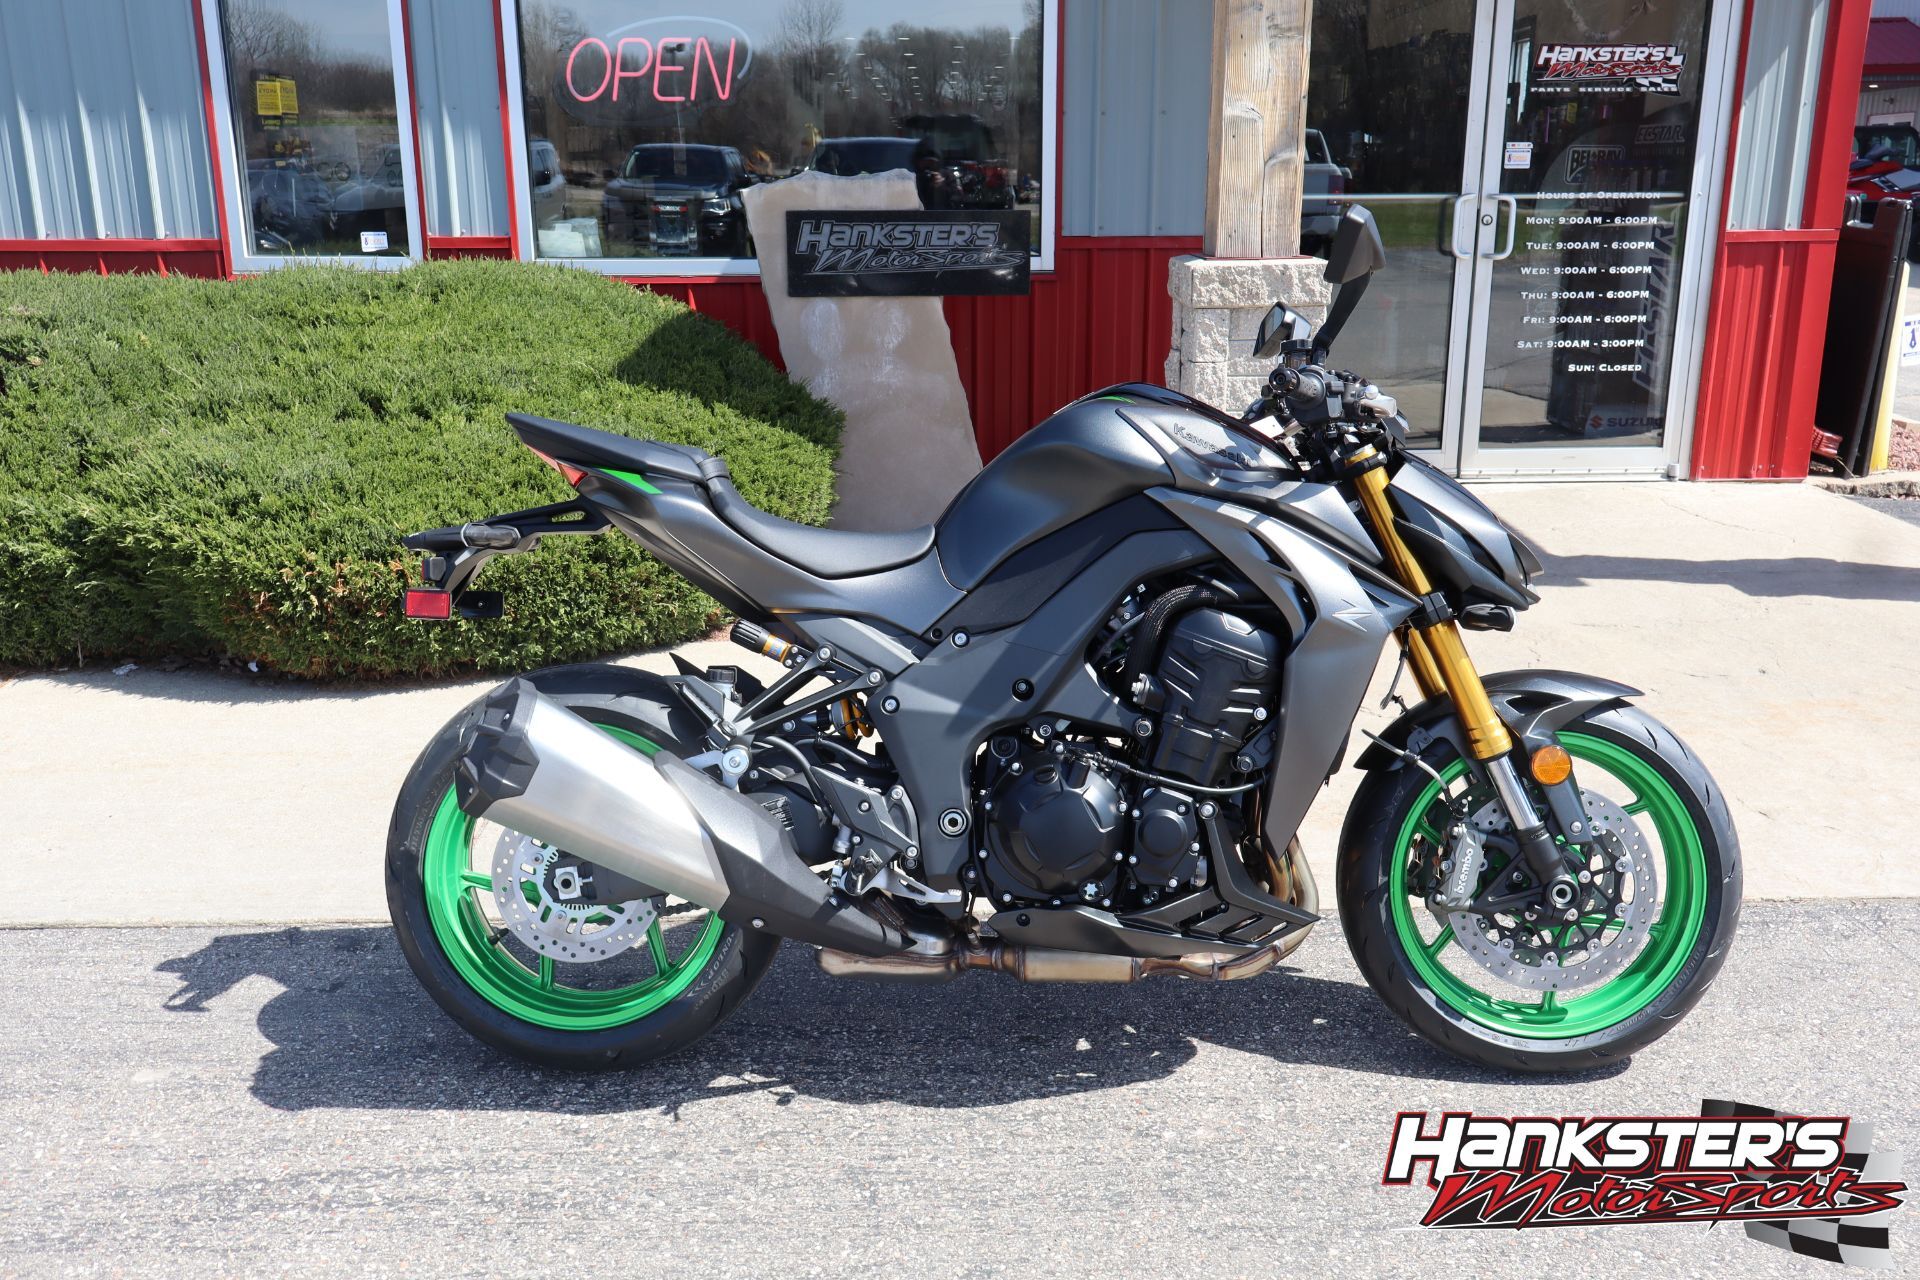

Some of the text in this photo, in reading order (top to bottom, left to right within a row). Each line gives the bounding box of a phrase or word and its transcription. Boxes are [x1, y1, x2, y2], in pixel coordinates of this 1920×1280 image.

[566, 37, 736, 102] OPEN
[1558, 216, 1602, 225] 9:00AM
[1614, 216, 1657, 224] 6:00PM
[1556, 241, 1600, 250] 9:00AM
[1611, 241, 1655, 249] 6:00PM
[1553, 266, 1597, 274] 9:00AM
[1609, 266, 1652, 274] 6:00PM
[1551, 291, 1595, 299] 9:00AM
[1606, 291, 1649, 299] 6:00PM
[1549, 315, 1592, 324] 9:00AM
[1604, 315, 1647, 323] 6:00PM
[1546, 340, 1590, 348] 9:00AM
[1601, 339, 1644, 347] 3:00PM
[1454, 848, 1473, 893] brembo
